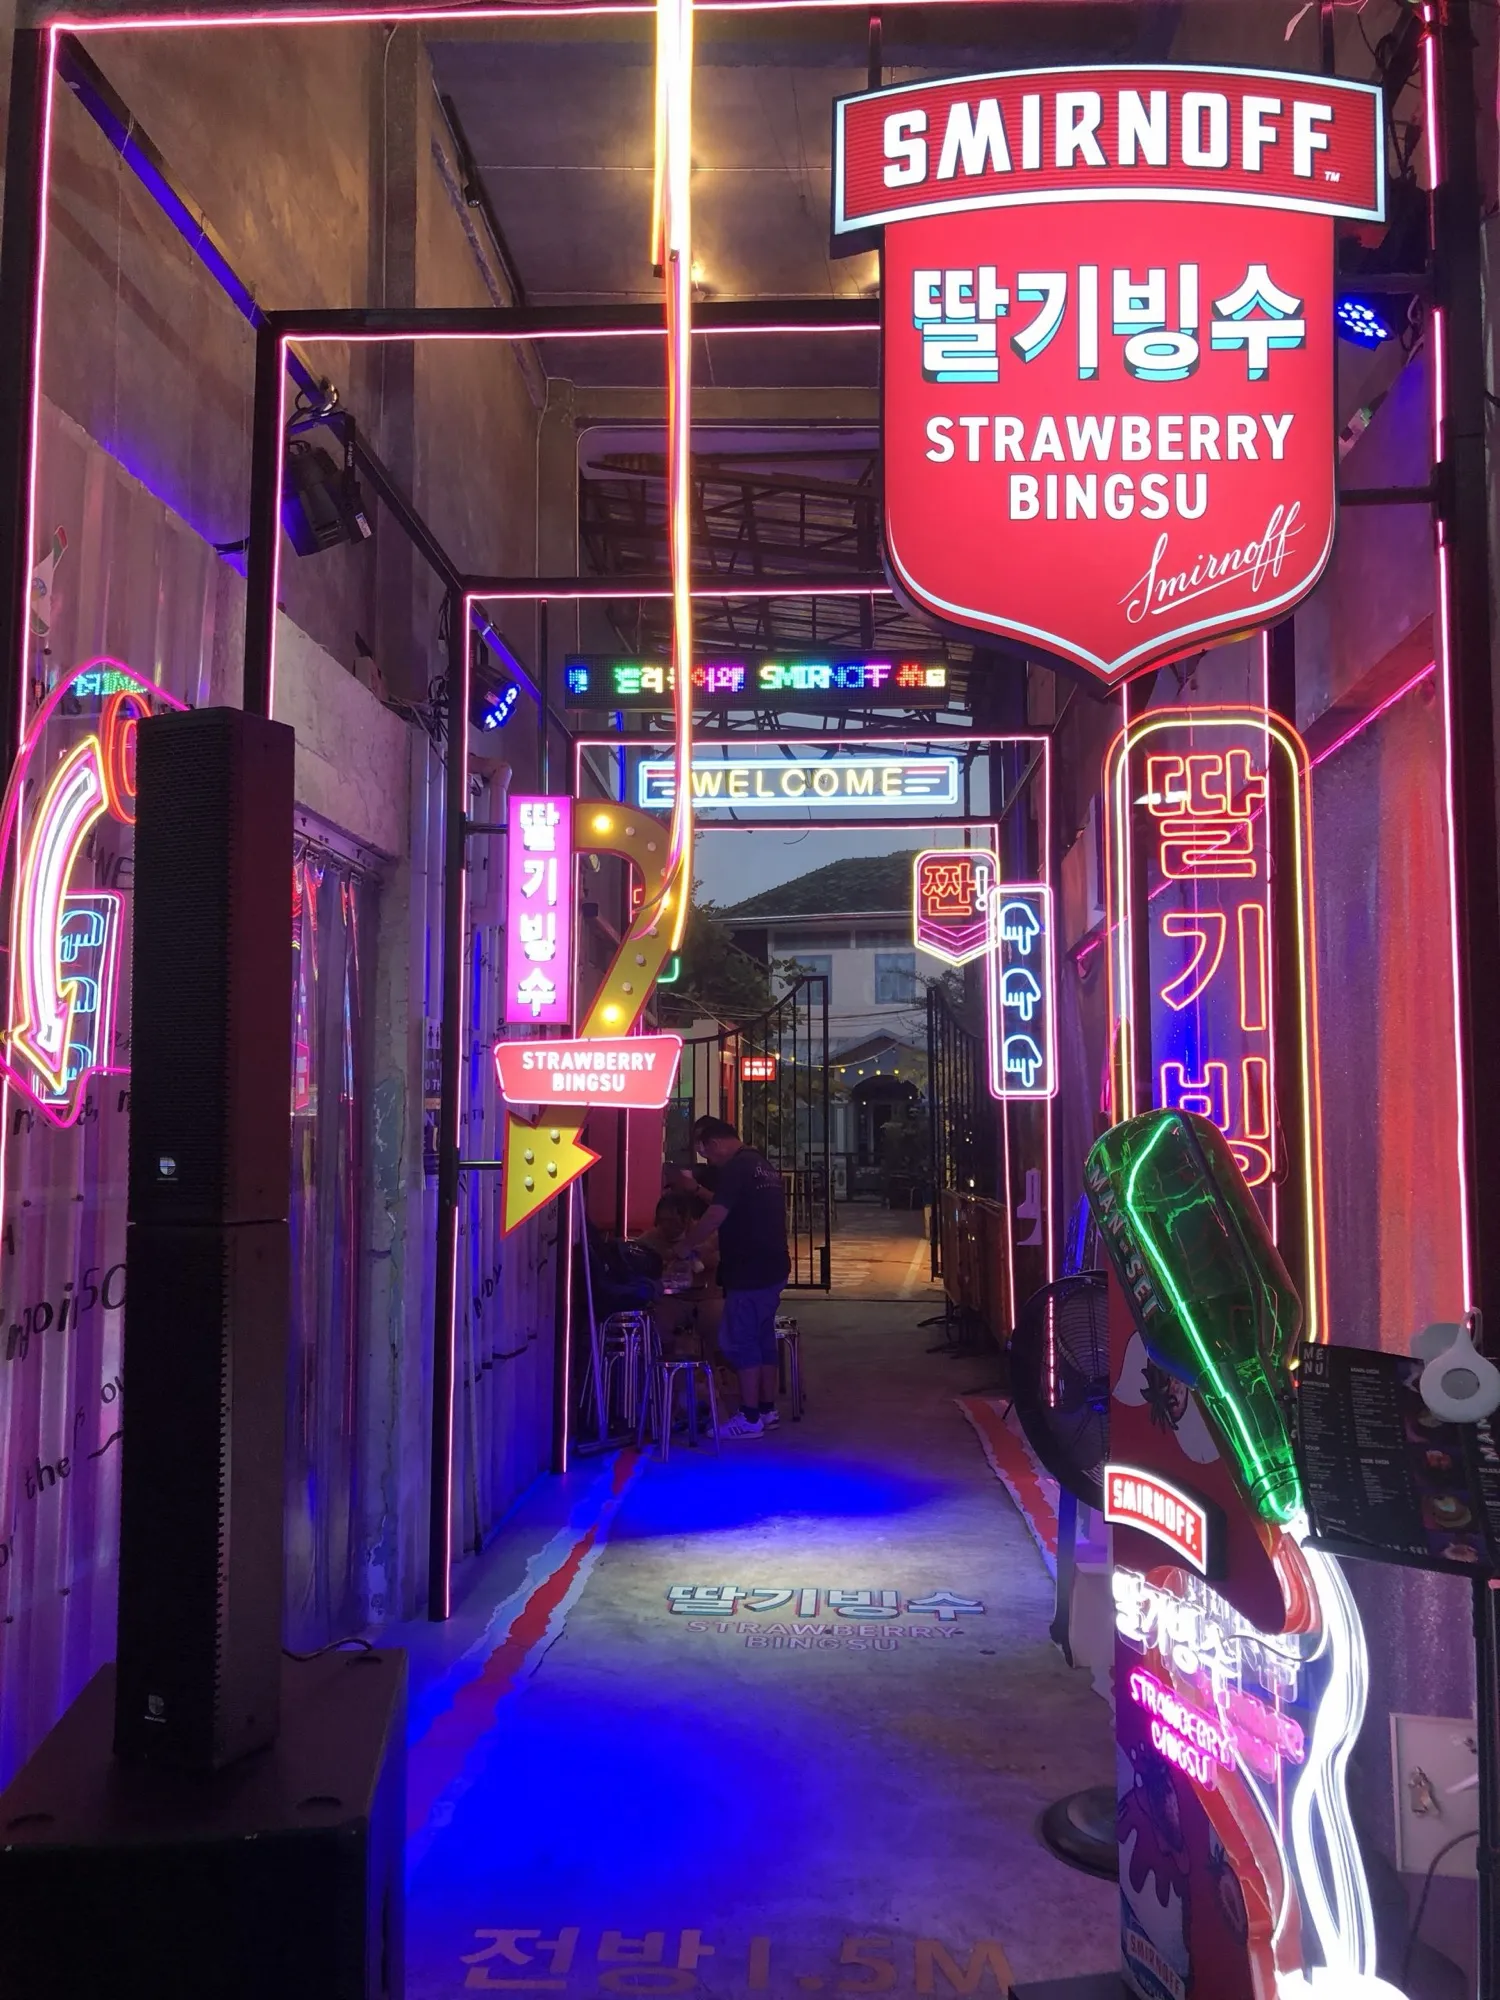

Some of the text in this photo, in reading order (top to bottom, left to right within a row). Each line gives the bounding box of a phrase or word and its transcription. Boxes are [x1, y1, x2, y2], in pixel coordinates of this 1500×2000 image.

[883, 90, 1333, 188] SMIRNOFF
[911, 262, 1308, 383] 딸기빙수
[925, 413, 1295, 463] STRAWBERRY
[1008, 472, 1209, 521] BINGSU
[1117, 501, 1306, 624] Smirnoff
[691, 766, 904, 798] WELCOME
[517, 801, 561, 1018] 딸기빙수
[922, 862, 989, 916] 짠!
[521, 1051, 657, 1072] STRAWBERRY
[551, 1072, 626, 1093] BINGSU
[1112, 1476, 1197, 1545] SMIRNOFF
[666, 1584, 987, 1621] 딸기빙수
[685, 1619, 958, 1640] STRAWBERRY
[743, 1635, 900, 1652] BINGSU
